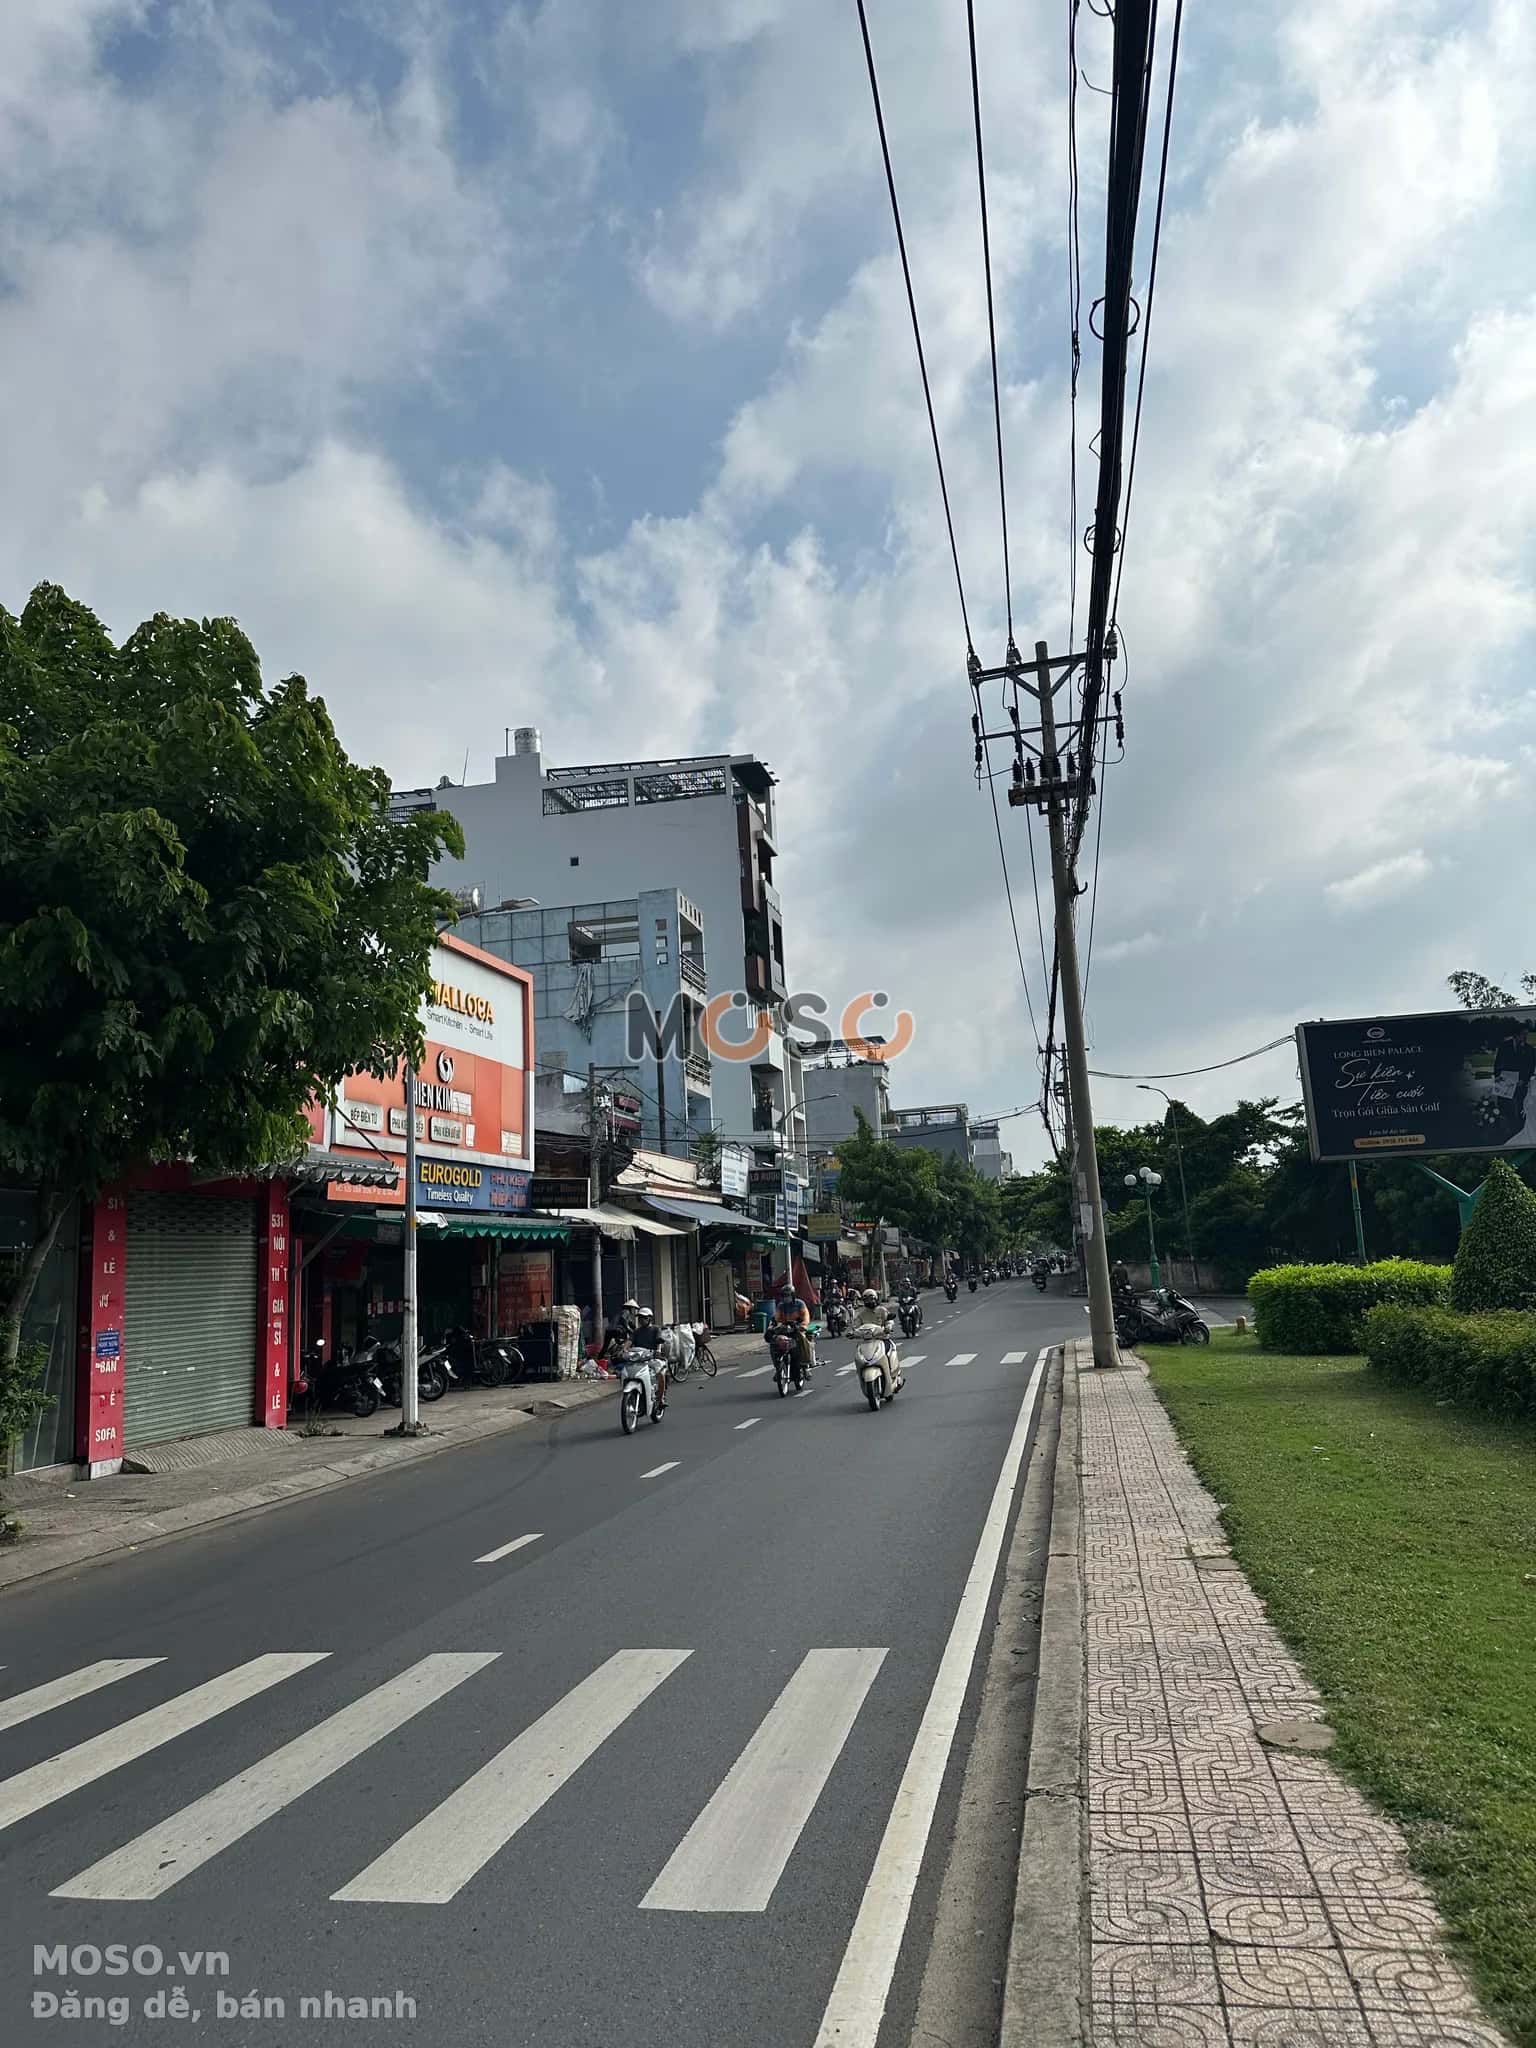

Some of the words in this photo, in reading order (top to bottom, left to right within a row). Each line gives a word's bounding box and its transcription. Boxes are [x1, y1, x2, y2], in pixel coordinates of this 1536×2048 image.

[1333, 1049, 1362, 1059] LONG
[1387, 1046, 1424, 1057] PALACE
[436, 1085, 453, 1112] KIM
[1357, 1105, 1374, 1117] Gói
[1420, 1101, 1441, 1112] Golf
[420, 1162, 482, 1187] EUROGOLD
[426, 1187, 452, 1202] Timeless
[453, 1190, 474, 1206] Quality
[272, 1214, 283, 1227] 531
[108, 1230, 116, 1241] &
[273, 1234, 285, 1254] NỘI
[274, 1363, 280, 1377] &
[272, 1390, 281, 1410] LẺ
[95, 1427, 116, 1442] SOFA
